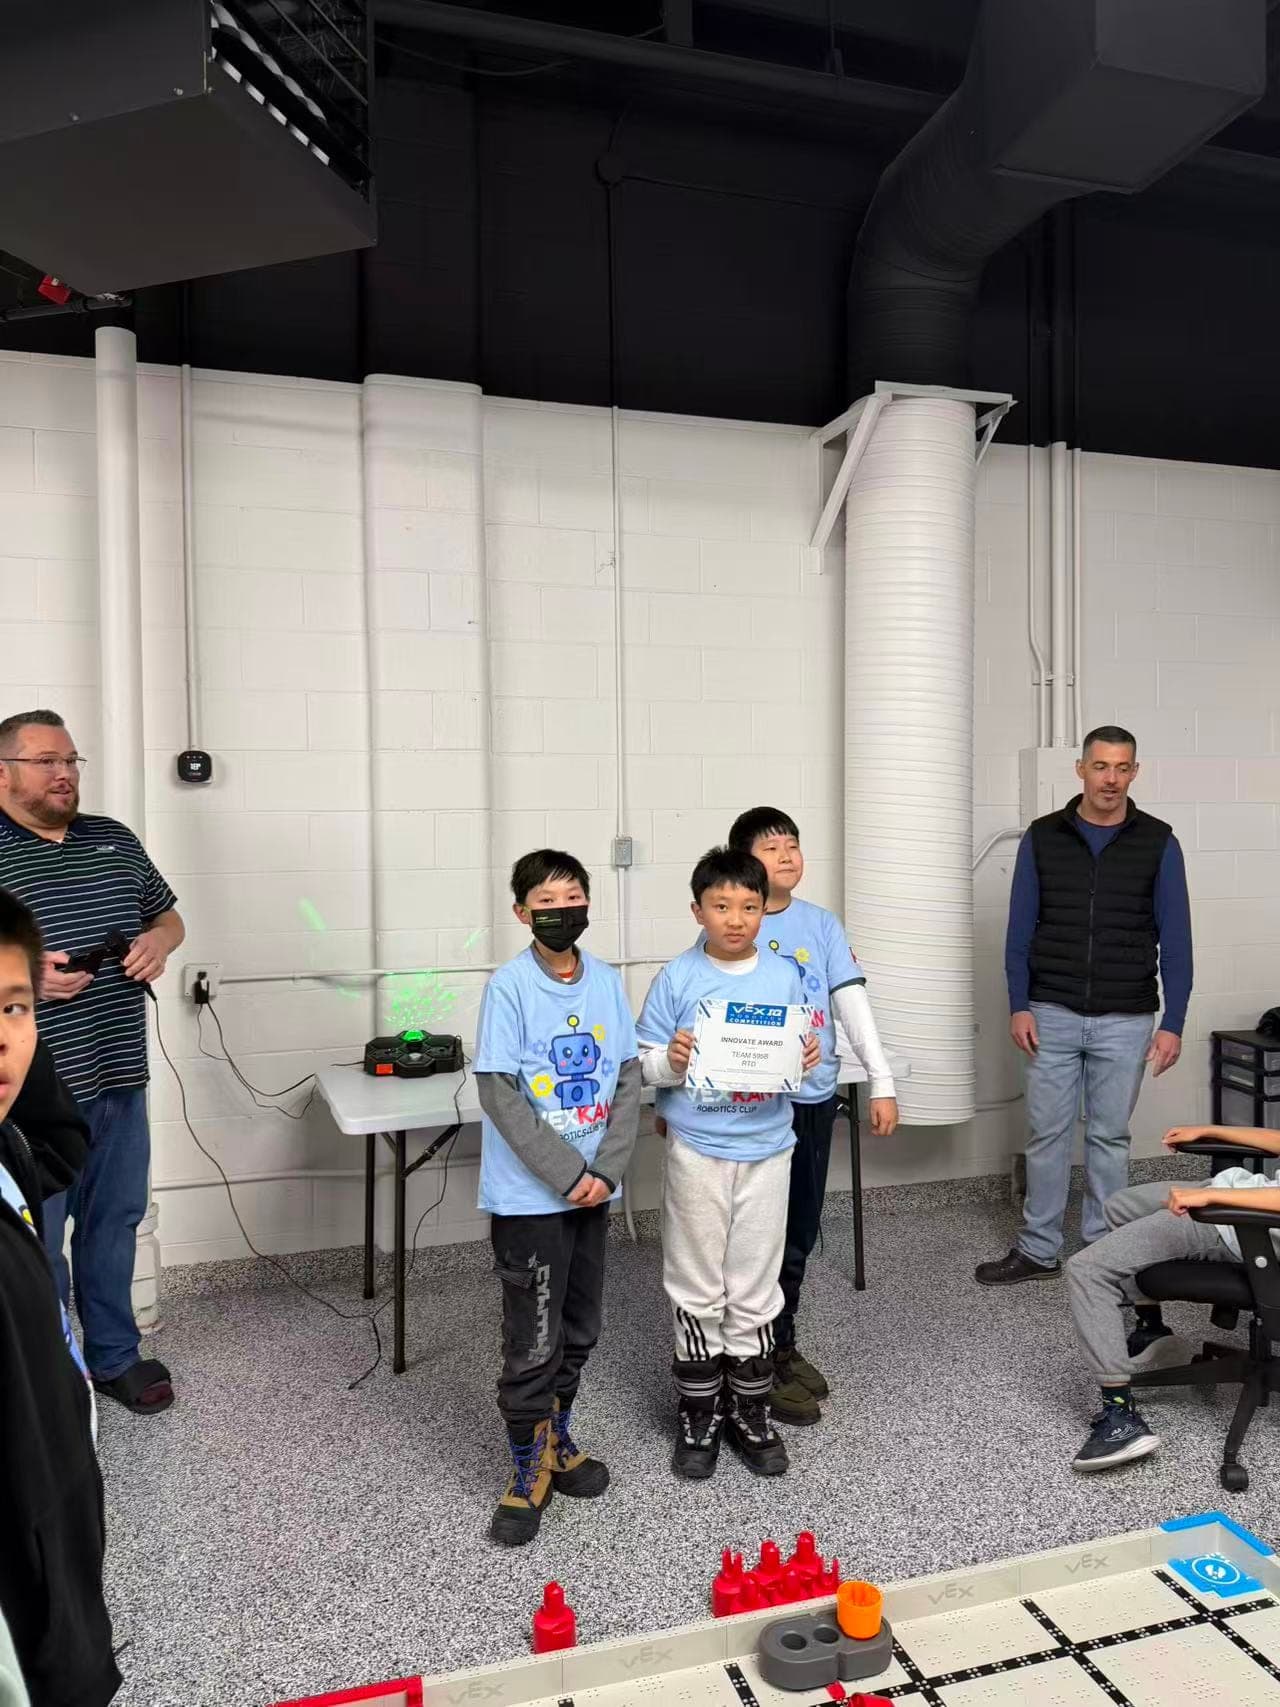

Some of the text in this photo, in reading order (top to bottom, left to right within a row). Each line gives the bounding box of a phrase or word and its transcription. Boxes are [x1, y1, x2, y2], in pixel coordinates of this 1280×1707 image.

[732, 1001, 767, 1016] VEX
[729, 1017, 782, 1026] COMPETITION
[721, 1036, 784, 1047] INNOVATE AWARD
[732, 1050, 751, 1059] TEAM
[696, 1104, 738, 1114] ROBOTICS
[1065, 1553, 1111, 1574] VEX
[927, 1583, 974, 1605] VEX
[621, 1646, 674, 1669] VEX
[449, 1680, 504, 1704] VEX
